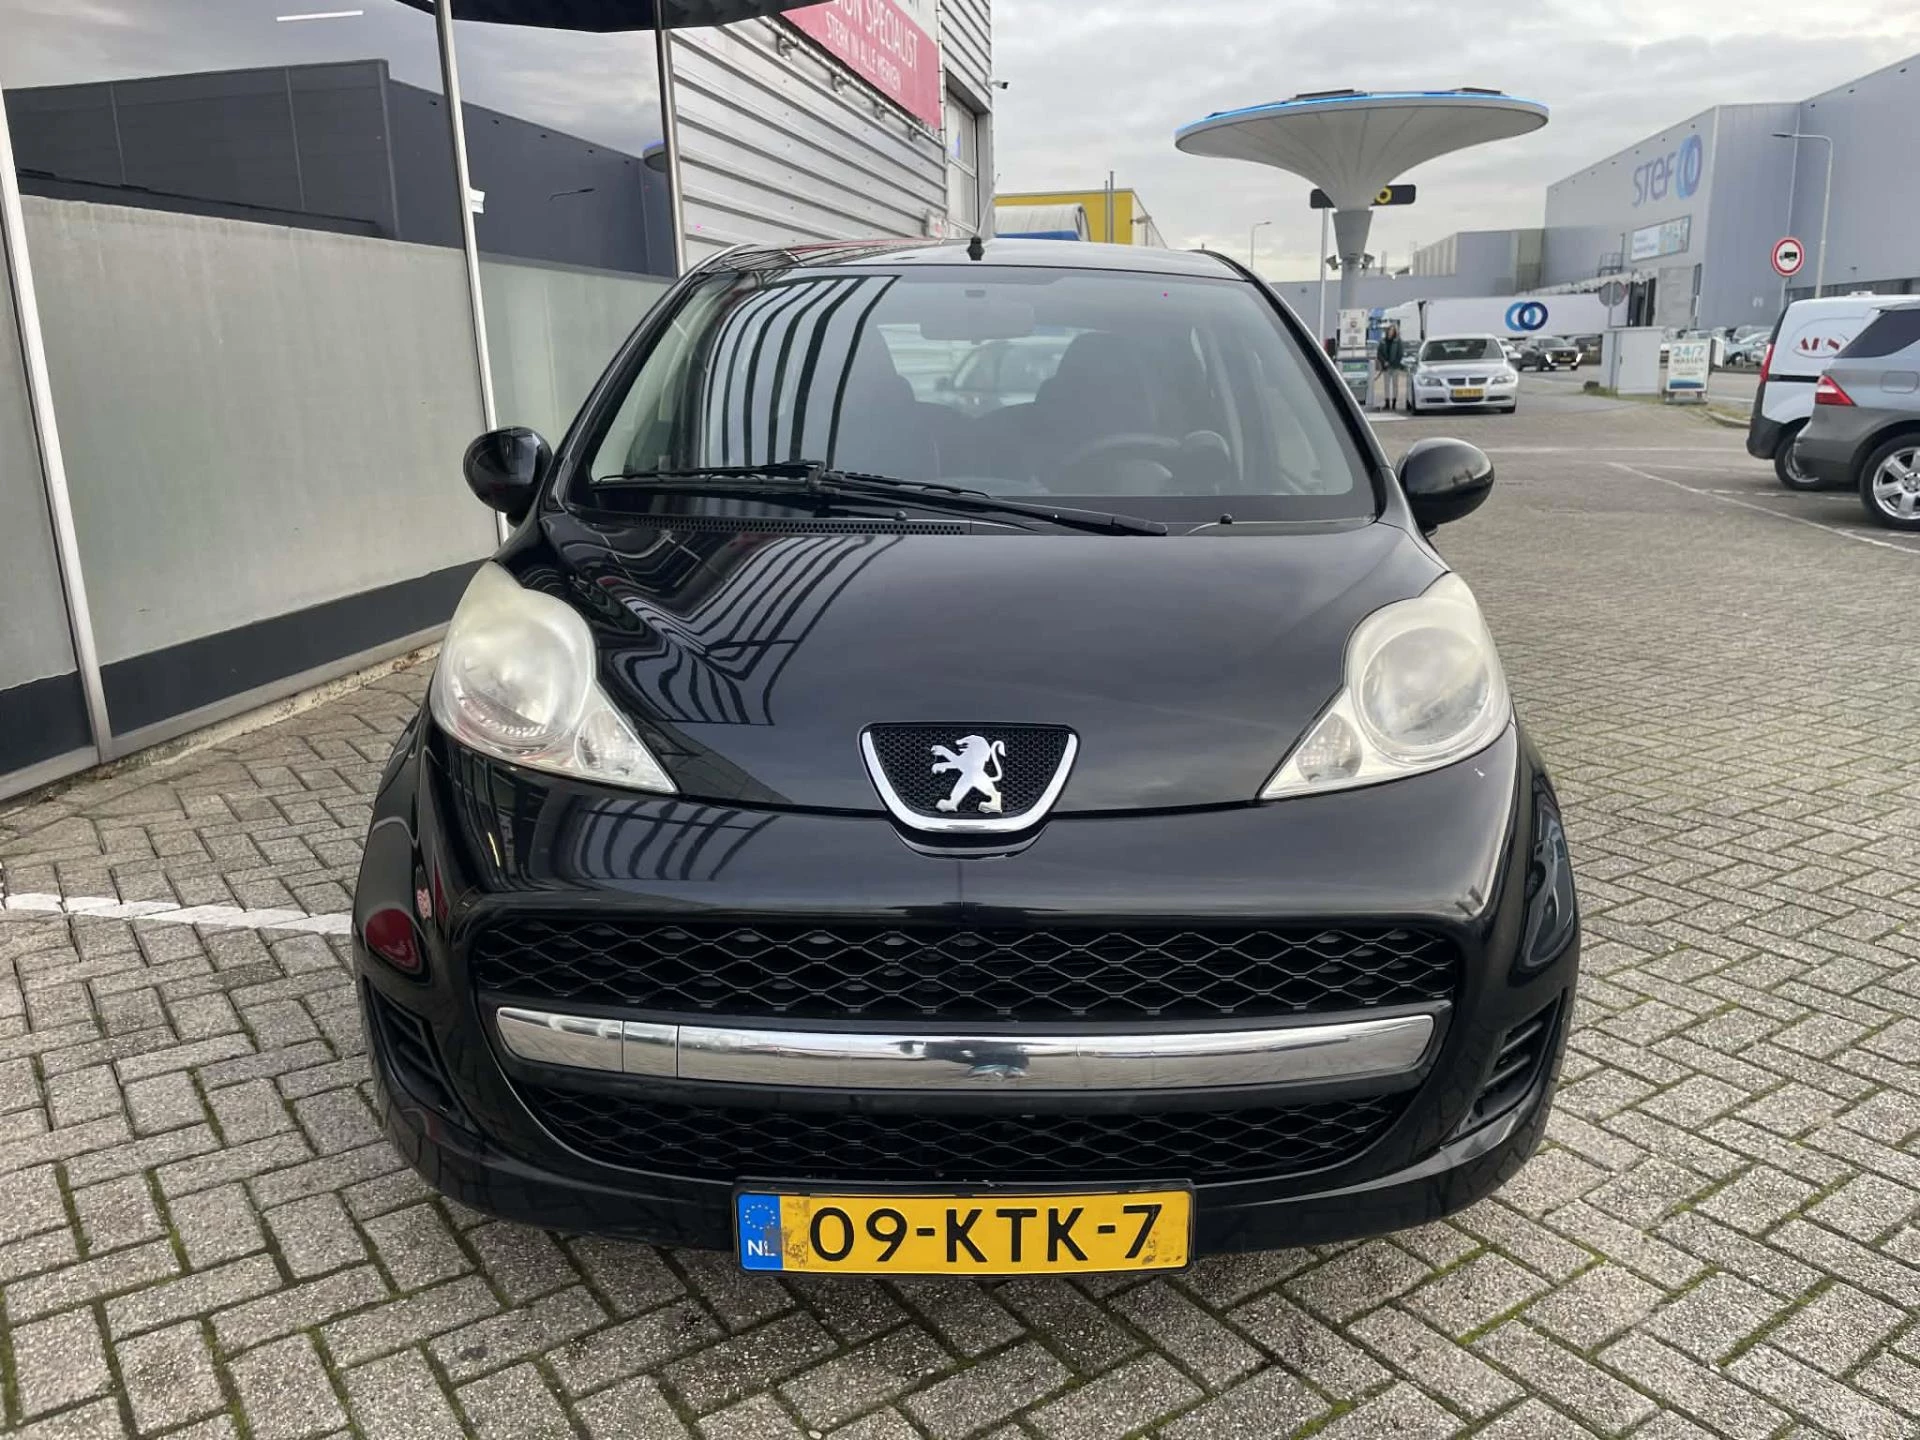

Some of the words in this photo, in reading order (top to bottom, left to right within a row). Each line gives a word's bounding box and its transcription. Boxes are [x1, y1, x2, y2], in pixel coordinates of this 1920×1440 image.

[865, 0, 917, 71] SPECIALIST
[747, 1239, 776, 1256] NL
[809, 1203, 1162, 1263] 09-KTK-7
